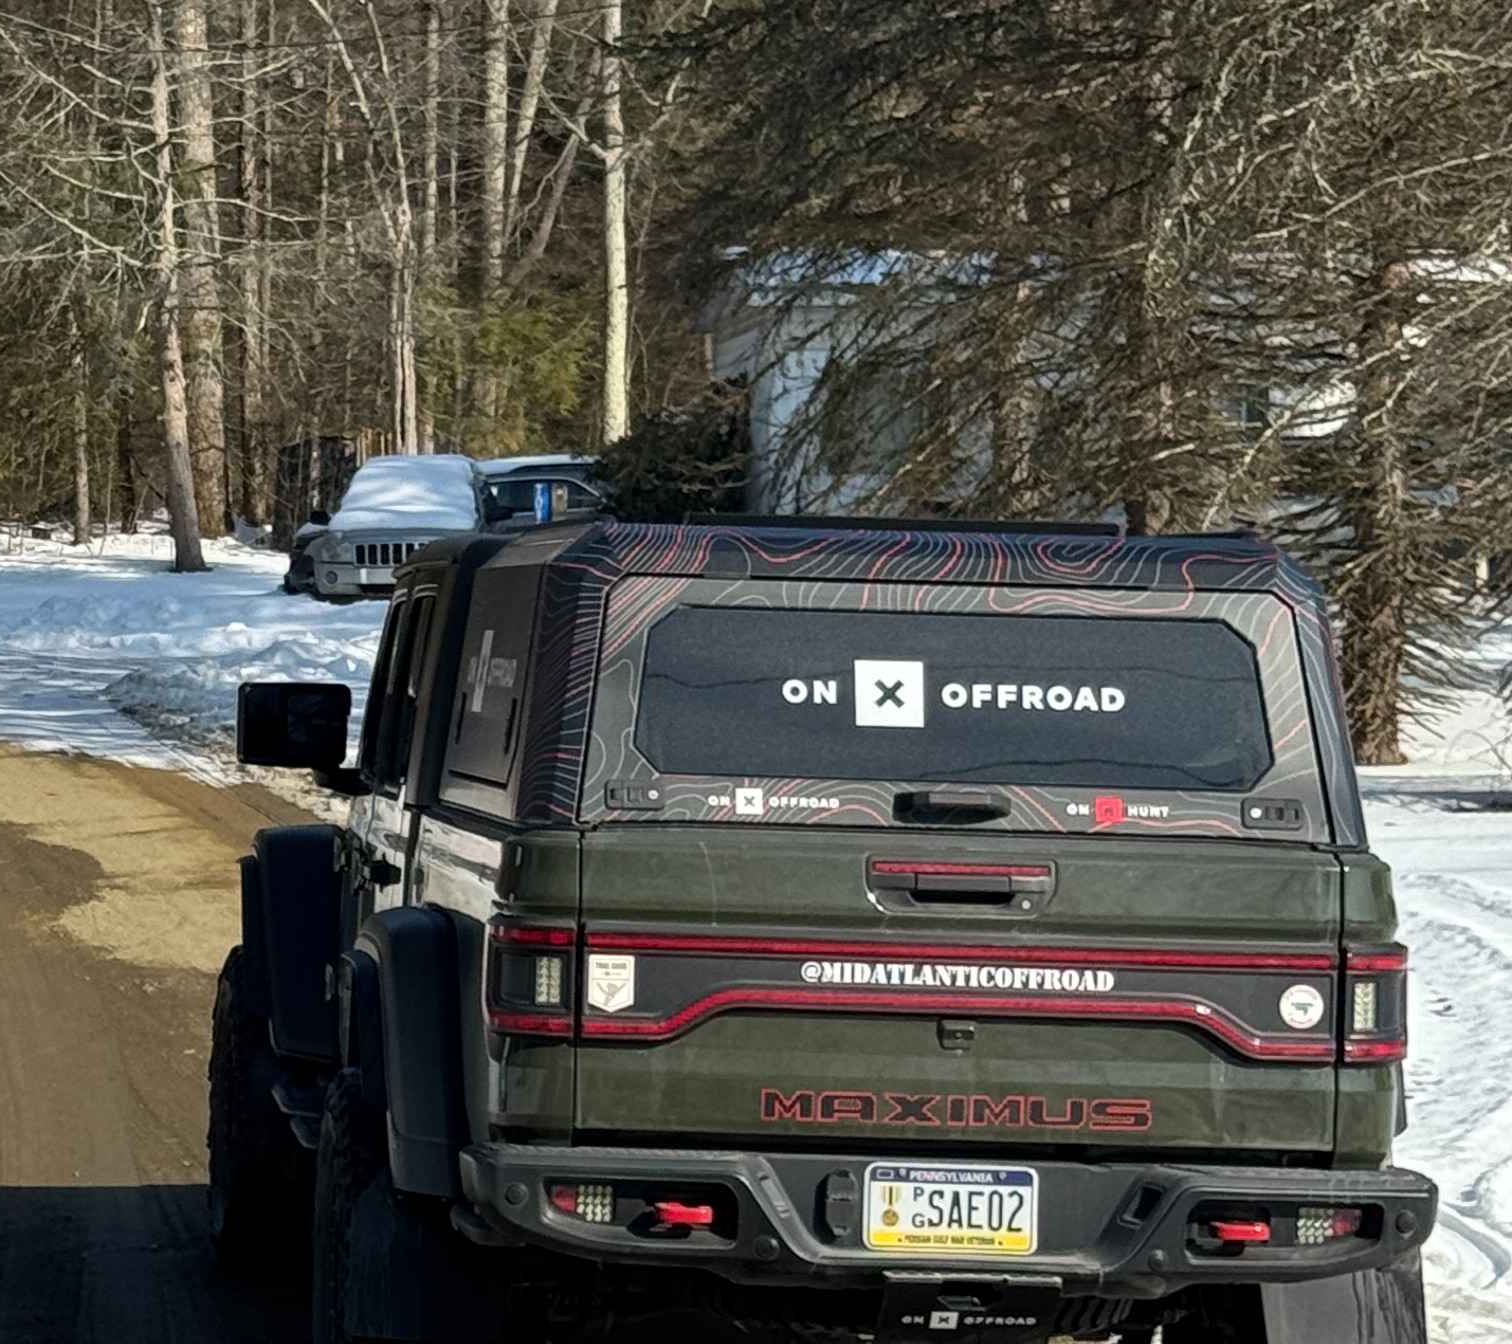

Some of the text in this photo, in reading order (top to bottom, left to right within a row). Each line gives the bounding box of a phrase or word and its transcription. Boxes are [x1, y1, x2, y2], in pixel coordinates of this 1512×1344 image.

[782, 679, 838, 705] ON
[941, 682, 1126, 713] OFFROAD
[707, 795, 731, 807] ON
[768, 796, 840, 809] OFFROAD
[1066, 803, 1169, 817] ON HUNT
[800, 961, 1115, 992] @MIDATLANTICOFFROAD
[761, 1088, 1152, 1132] MAXIMUS
[909, 1171, 994, 1183] PENNSYLVANIA
[901, 1315, 925, 1325] ON
[963, 1316, 1037, 1326] OFFROAD
